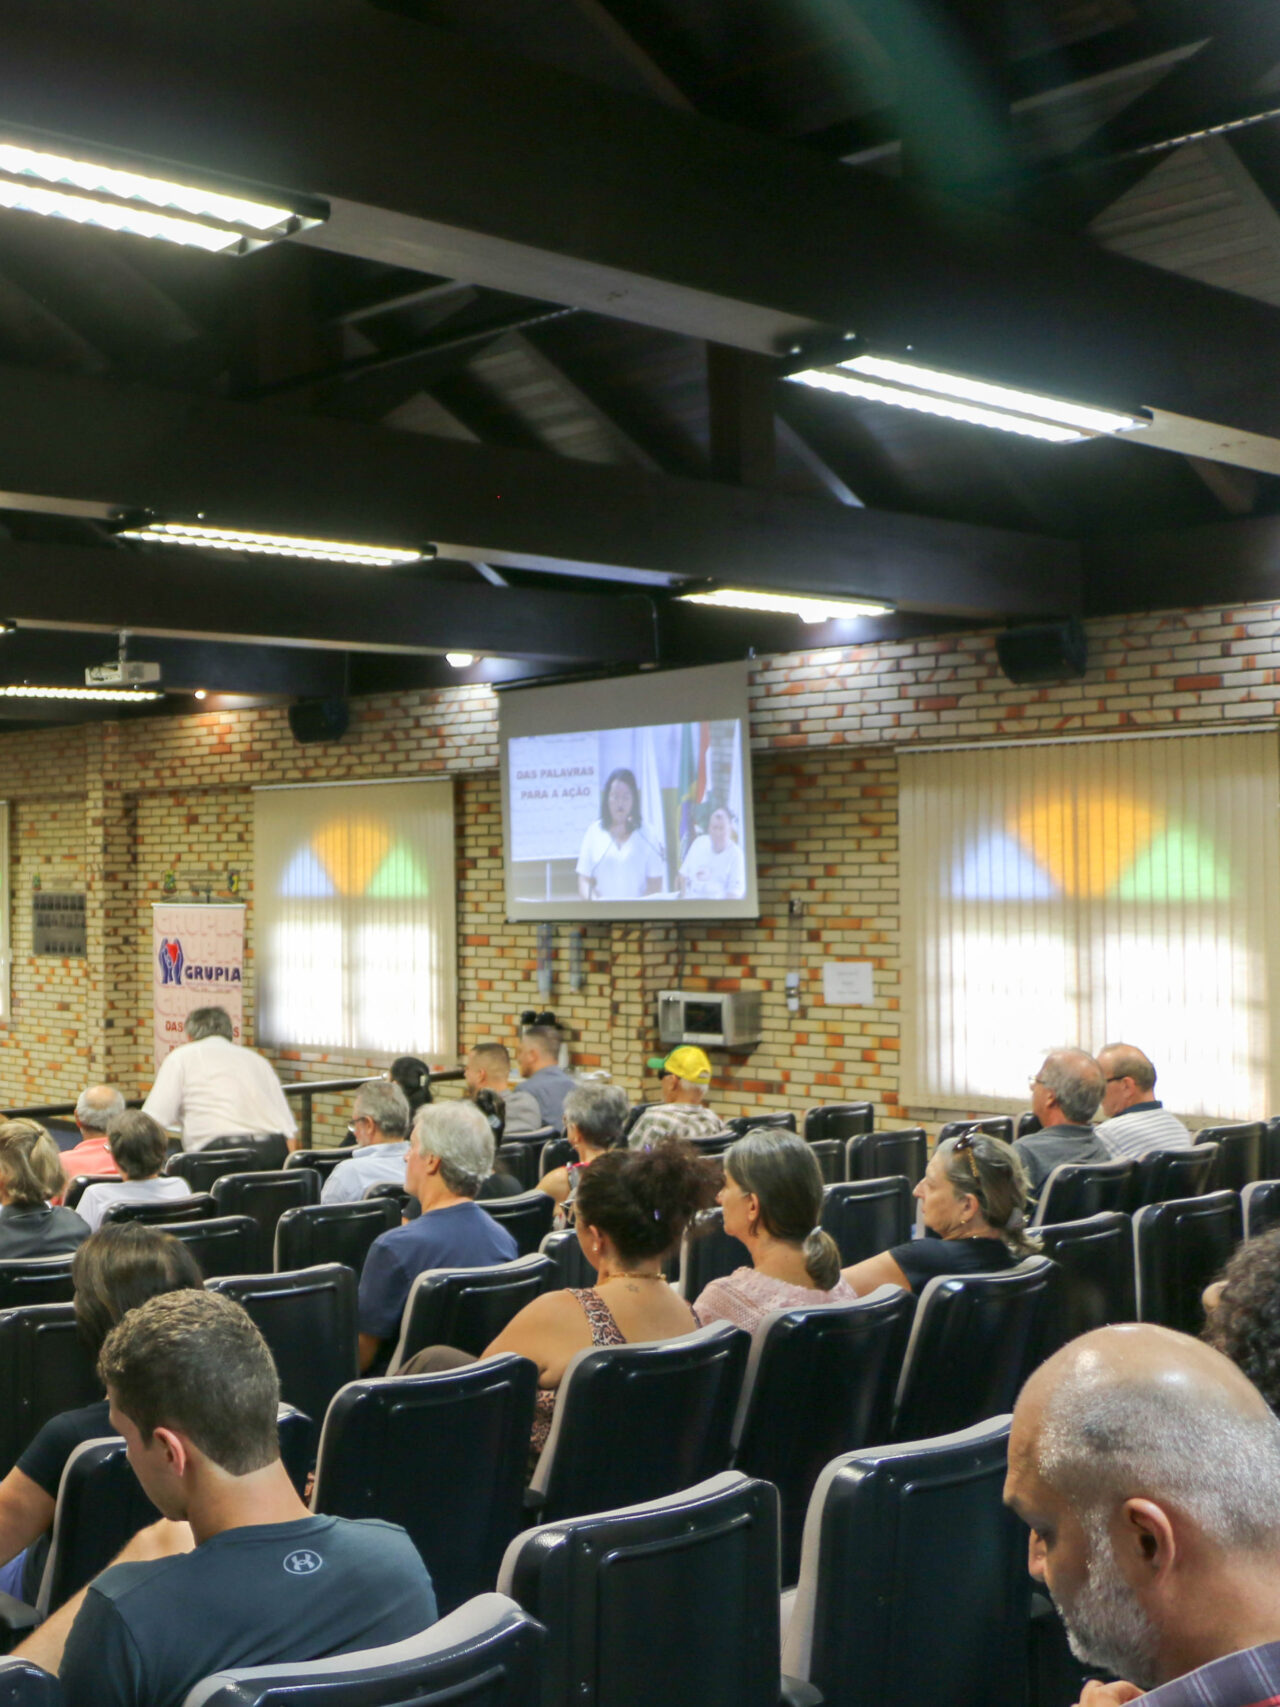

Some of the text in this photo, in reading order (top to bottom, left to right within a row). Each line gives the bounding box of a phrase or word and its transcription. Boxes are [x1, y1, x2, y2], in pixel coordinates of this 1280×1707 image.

[516, 766, 594, 780] DAS PALAVRAS
[521, 785, 591, 800] PARA A AÇÃO
[184, 965, 241, 982] GRUPIA
[165, 1020, 184, 1033] DAS
